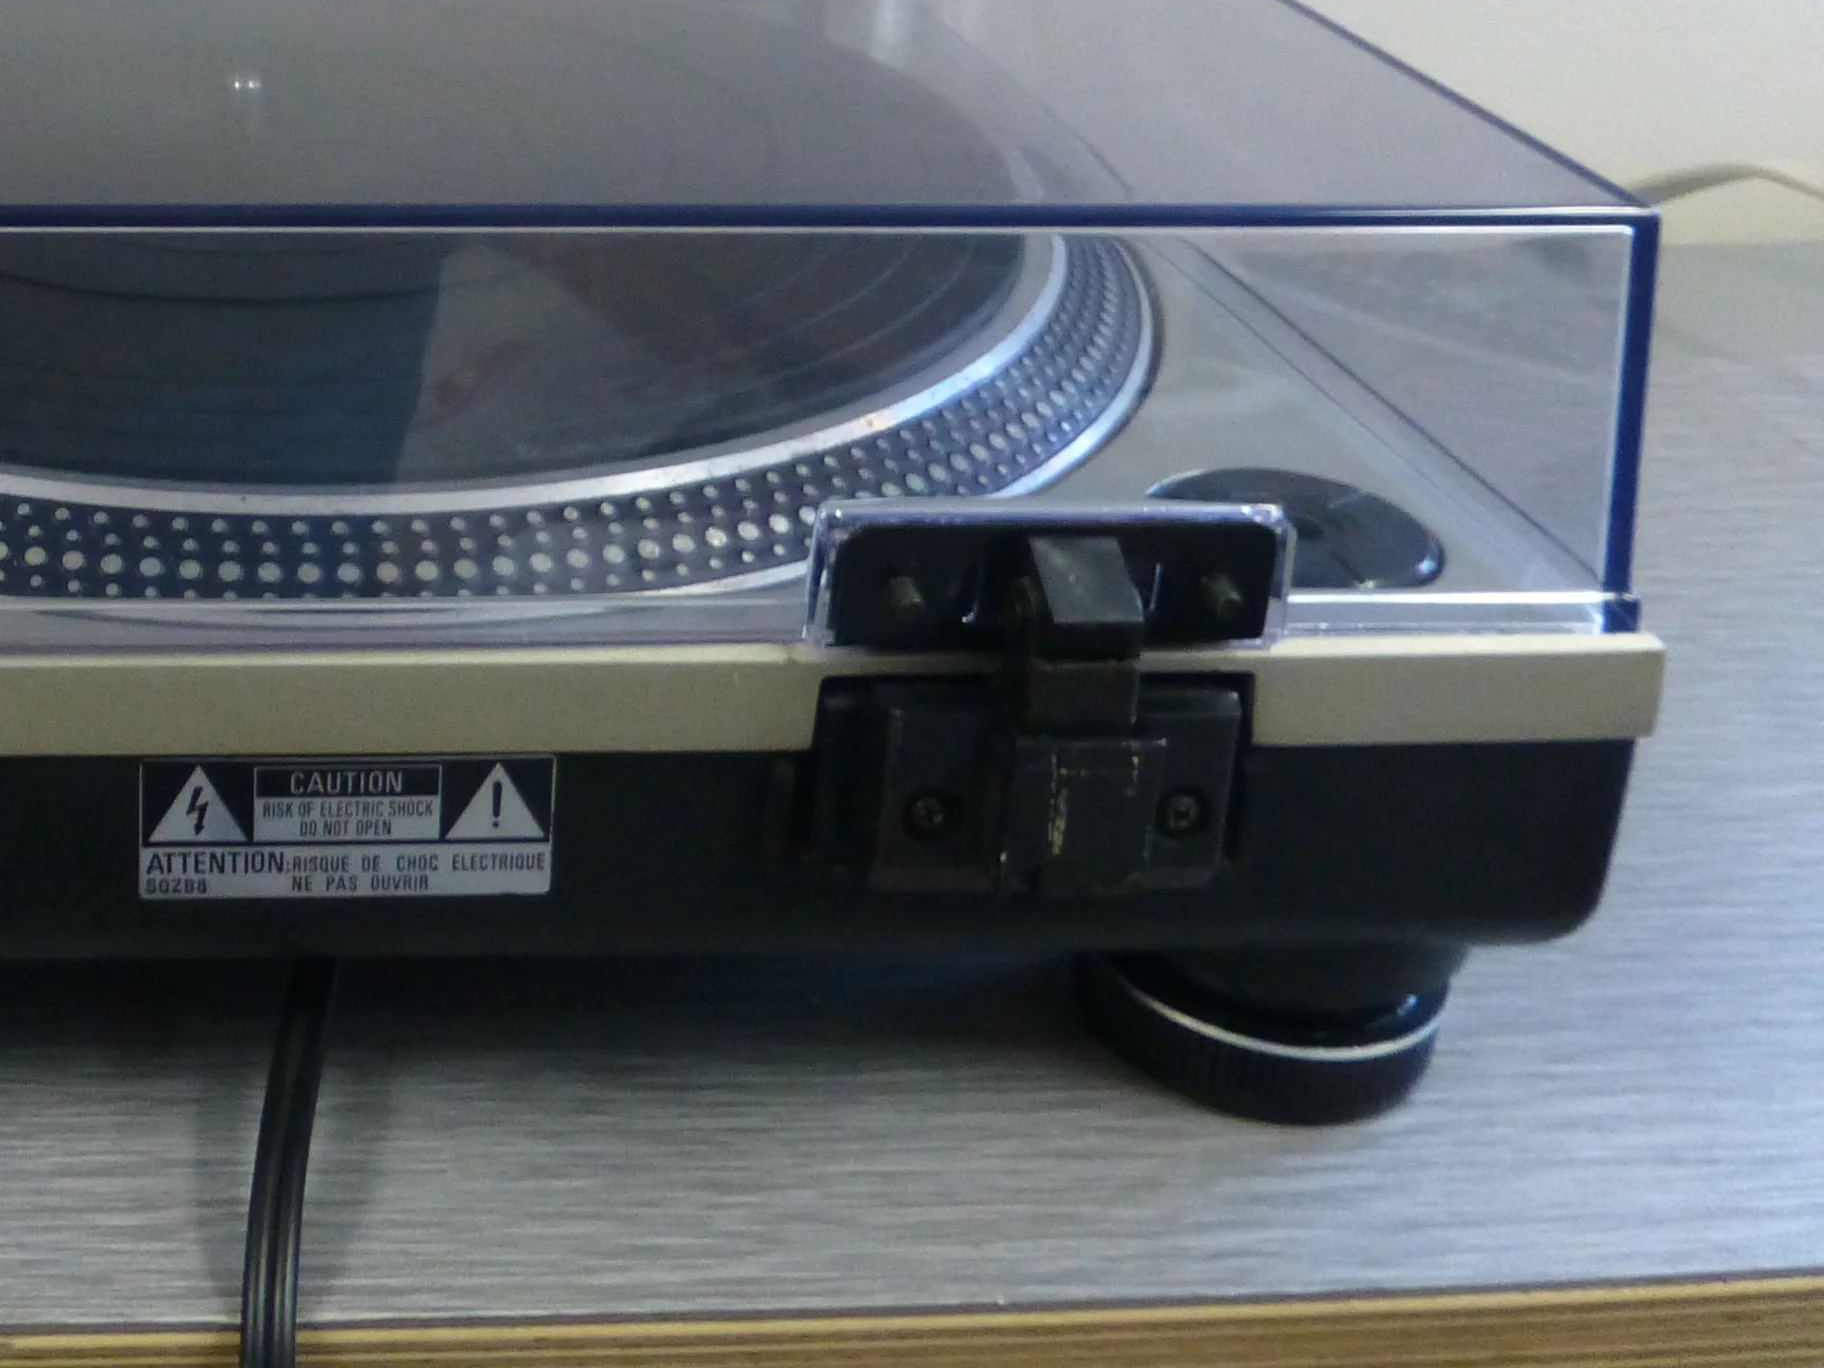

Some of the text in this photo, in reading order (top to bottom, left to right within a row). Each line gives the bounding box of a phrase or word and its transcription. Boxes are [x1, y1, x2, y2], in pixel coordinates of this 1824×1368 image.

[289, 770, 405, 794] CAUTION
[262, 799, 434, 819] RISK OF ELECTRIC SHOCK
[299, 820, 393, 838] DO NOT OPEN
[291, 854, 351, 873] RISQUE
[361, 855, 382, 873] DE
[396, 854, 440, 873] CHOC
[452, 852, 546, 872] ELECTRIQUE
[291, 873, 430, 892] NE PAS OUVRIR
